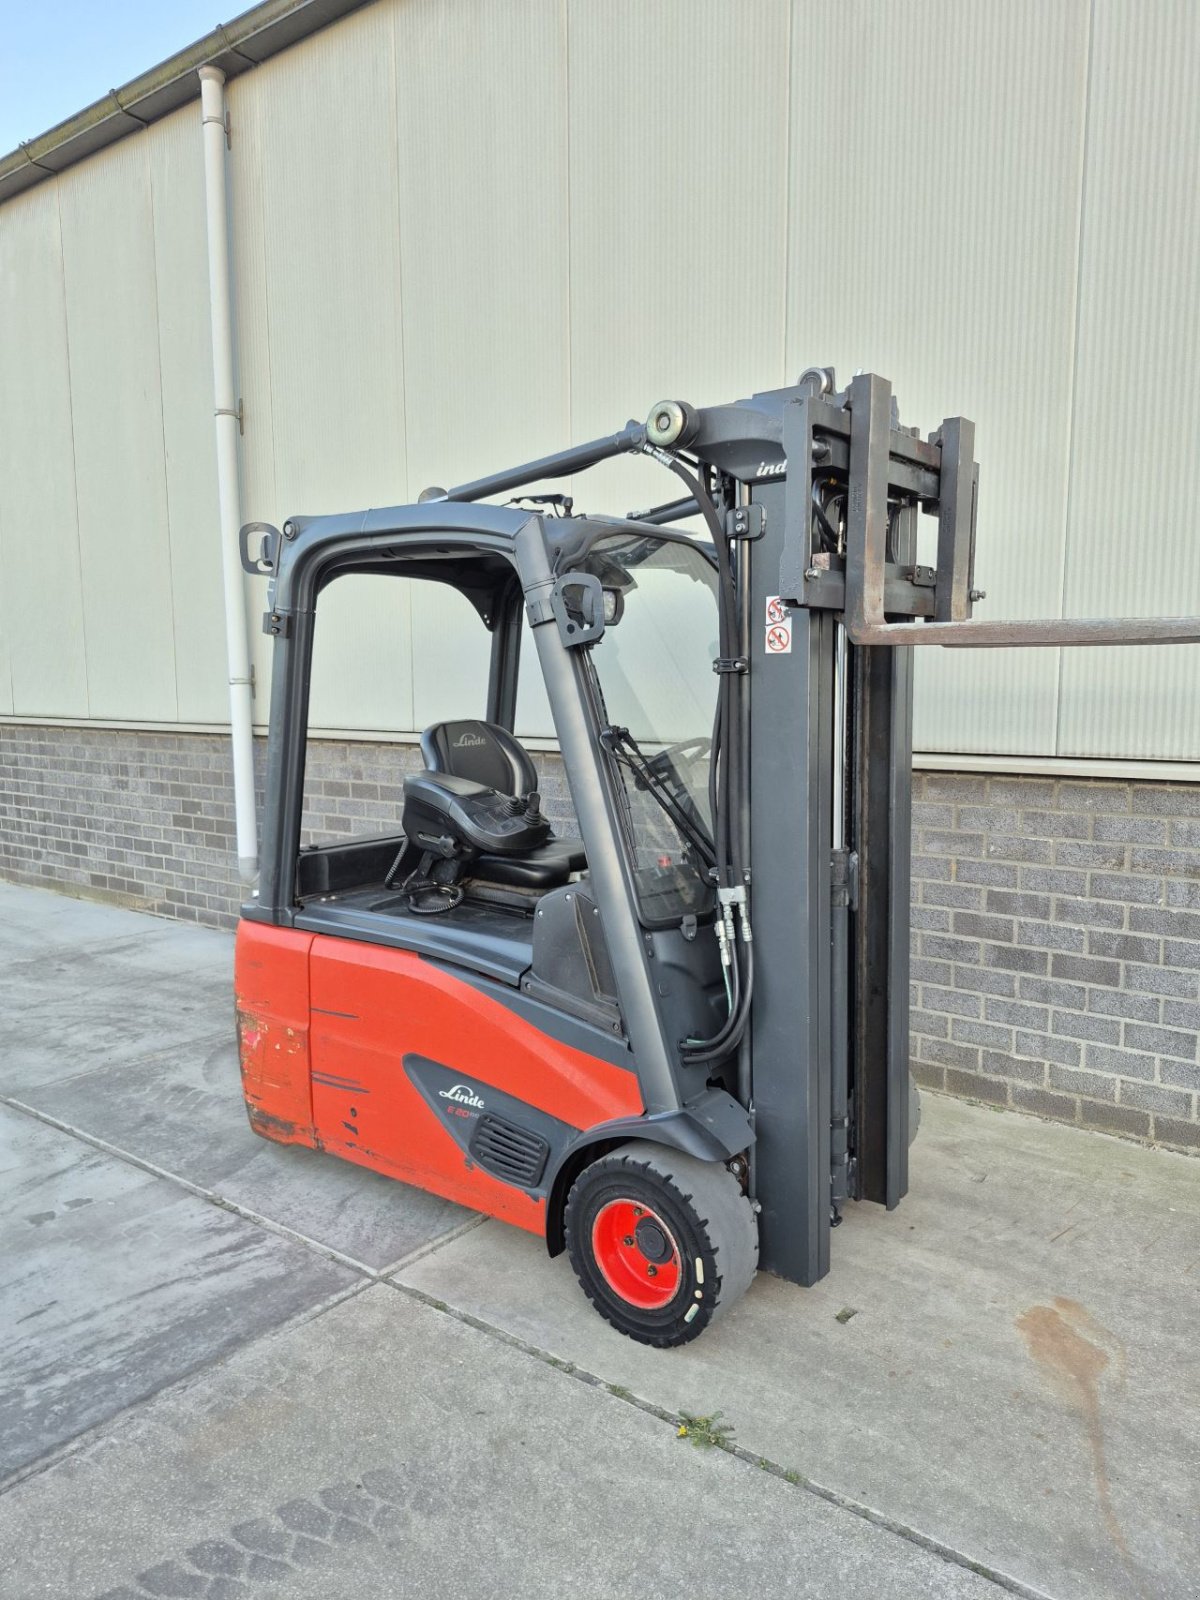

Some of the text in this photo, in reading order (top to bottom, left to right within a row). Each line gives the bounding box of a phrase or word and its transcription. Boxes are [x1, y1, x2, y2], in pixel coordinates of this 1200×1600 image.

[756, 459, 788, 477] ind
[452, 733, 487, 747] Linde
[438, 1084, 485, 1109] Linde
